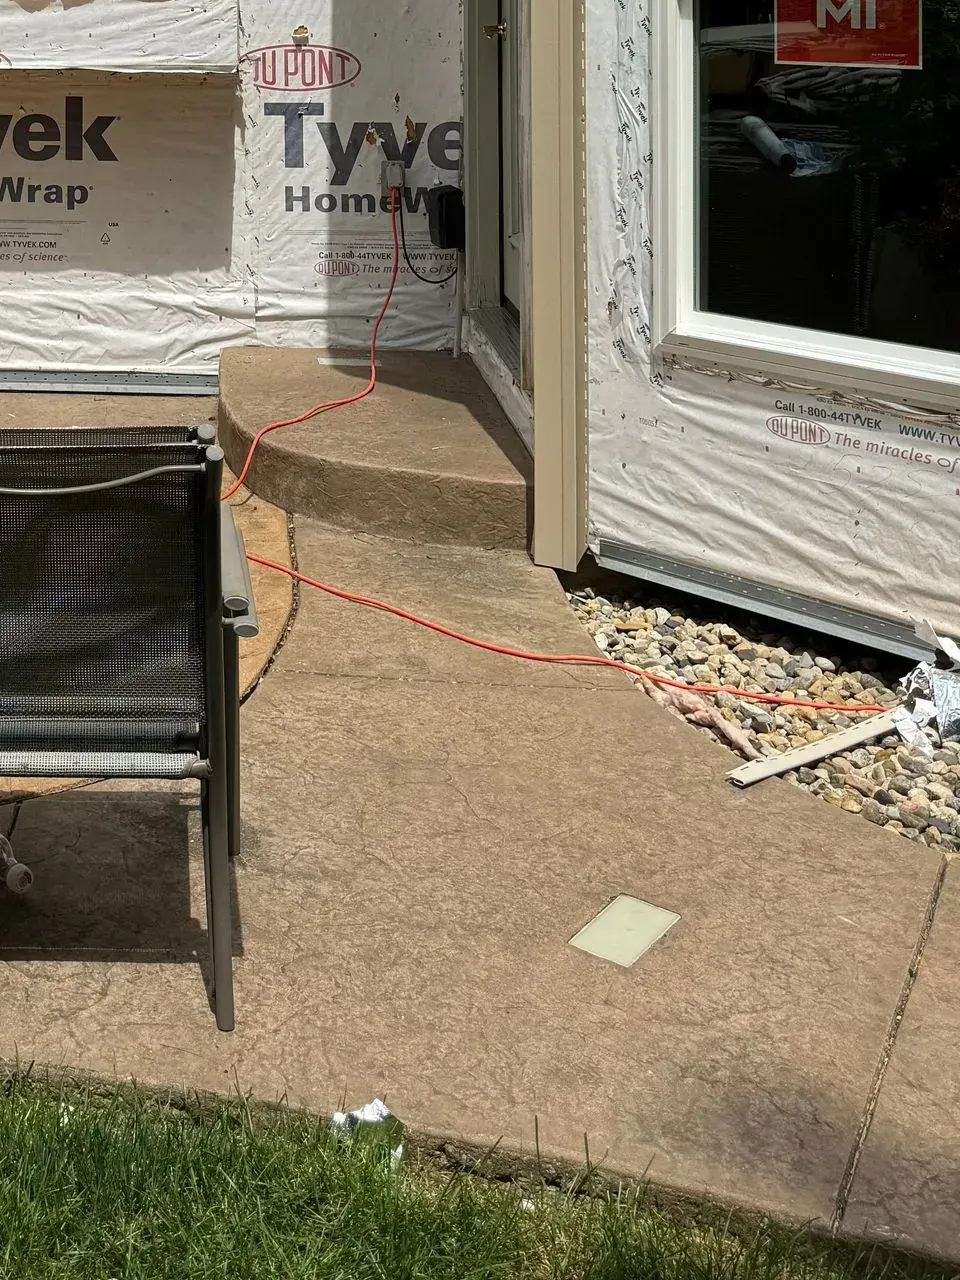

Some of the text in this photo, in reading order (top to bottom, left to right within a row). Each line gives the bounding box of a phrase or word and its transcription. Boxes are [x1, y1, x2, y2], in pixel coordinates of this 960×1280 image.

[13, 252, 27, 263] of
[28, 252, 64, 262] science
[335, 252, 392, 260] 1-800-44TYVEK
[362, 264, 380, 273] The
[429, 265, 443, 275] of
[775, 399, 795, 413] Call
[798, 404, 882, 430] 1-800-44TYVEK
[835, 432, 861, 449] The
[866, 441, 932, 465] miracles
[937, 457, 960, 474] of
